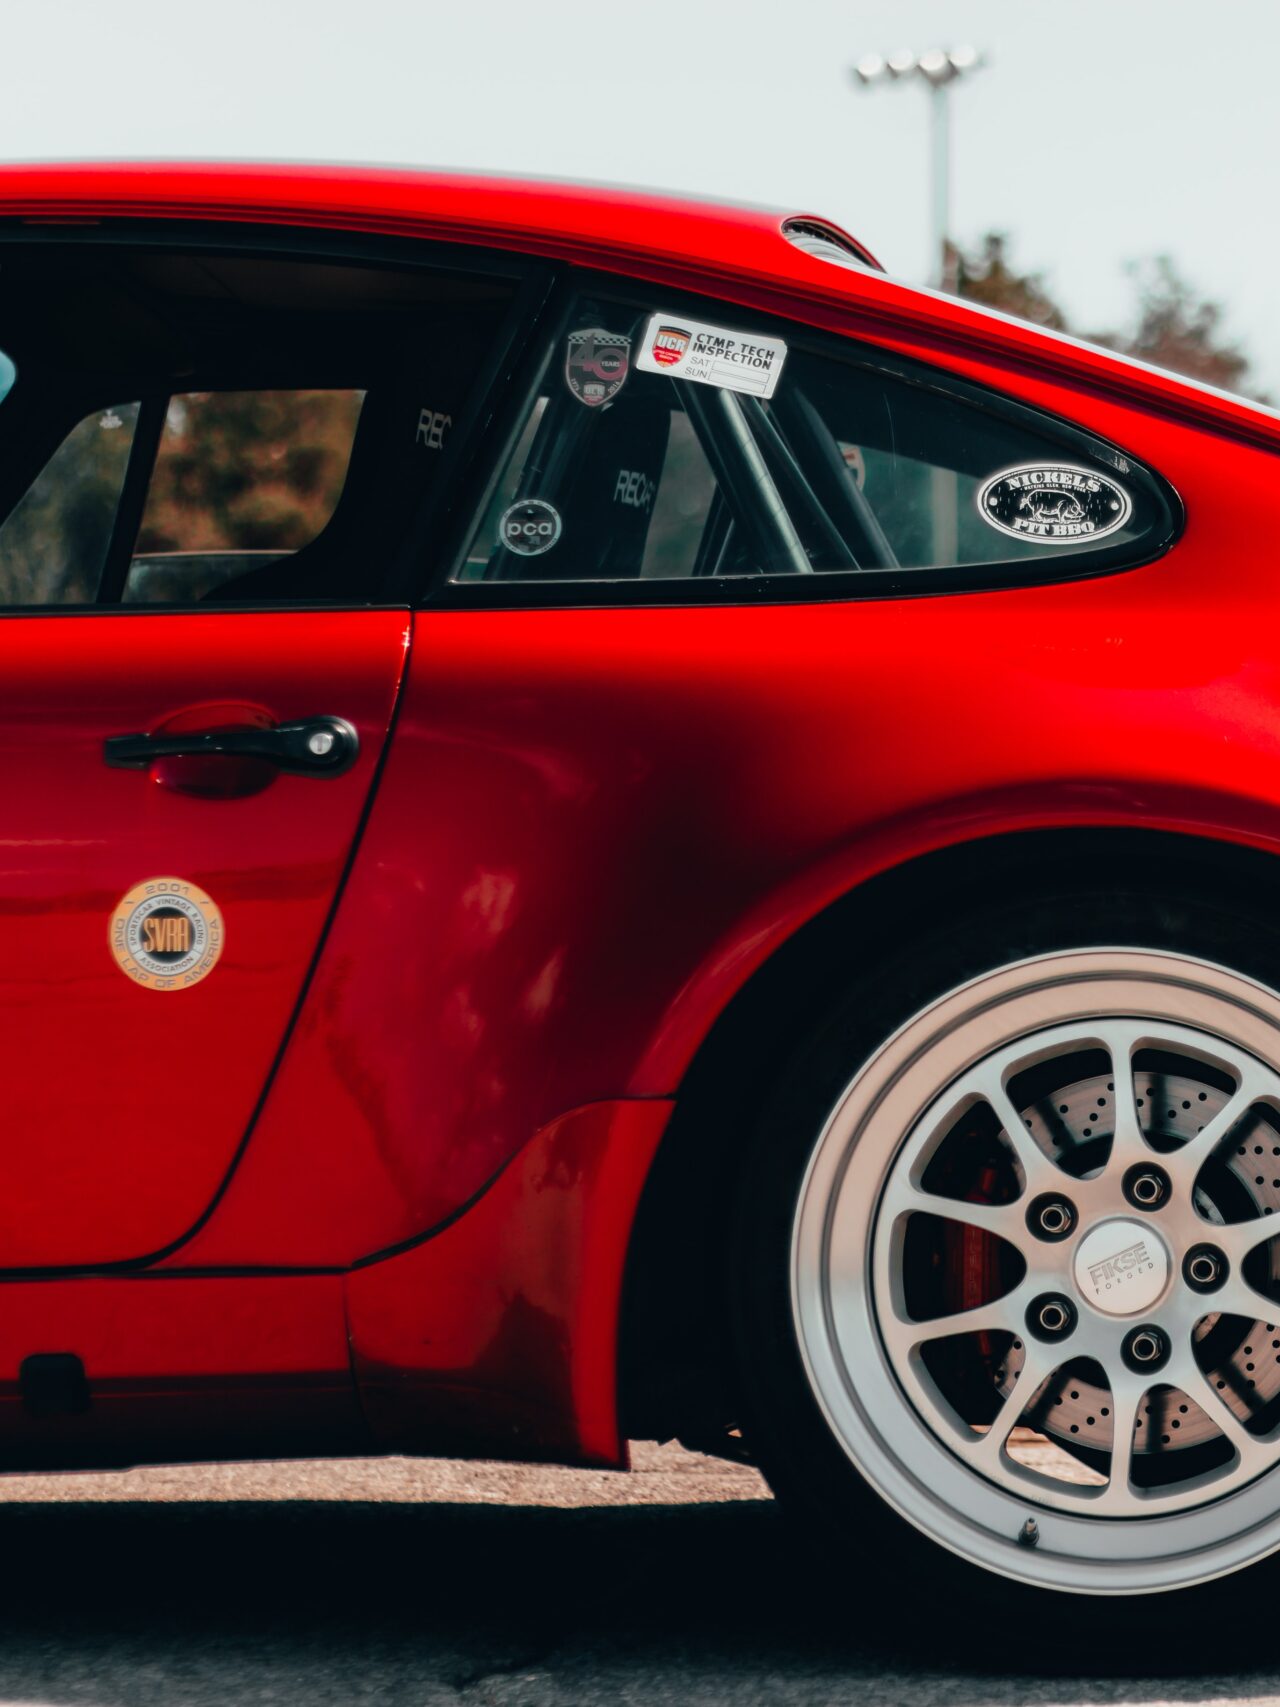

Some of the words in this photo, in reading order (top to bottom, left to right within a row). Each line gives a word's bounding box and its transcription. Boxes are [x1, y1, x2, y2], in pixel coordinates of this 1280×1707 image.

[657, 335, 687, 351] UCR
[696, 333, 735, 350] CTMP
[740, 343, 775, 360] TECH
[690, 356, 711, 367] SAT
[692, 342, 772, 370] INSPECTION
[684, 366, 708, 378] SUN
[1005, 471, 1100, 493] NICKELS
[507, 522, 552, 538] pca
[1012, 517, 1050, 535] PIT
[1052, 521, 1095, 535] BBQ
[144, 882, 190, 895] 2001
[155, 898, 190, 912] VINTAGE
[191, 912, 204, 945] RACING
[143, 917, 190, 953] SVRA
[115, 918, 126, 953] ONE
[122, 957, 149, 981] LAP
[154, 979, 176, 988] OF
[184, 918, 219, 985] AMERICA
[139, 956, 194, 973] ASSOCIATION
[1089, 1245, 1151, 1287] FIKSE
[1095, 1262, 1154, 1295] FORGED
